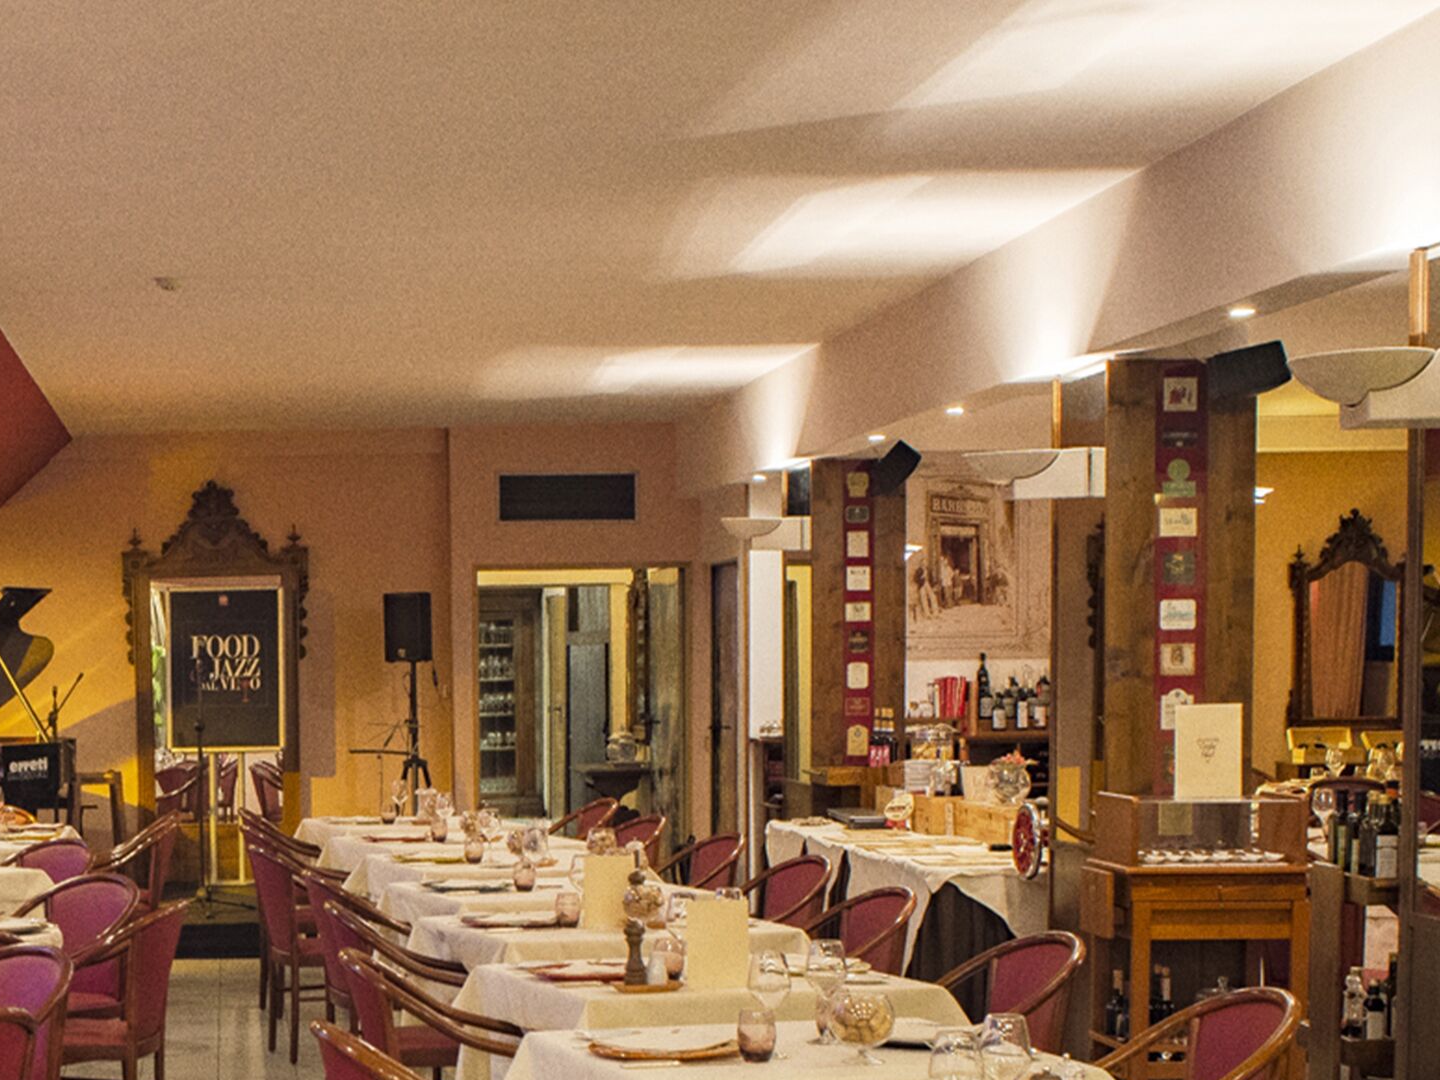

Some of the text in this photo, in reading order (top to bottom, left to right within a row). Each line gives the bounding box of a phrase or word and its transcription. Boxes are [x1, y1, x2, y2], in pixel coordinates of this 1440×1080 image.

[190, 635, 260, 659] FOOD
[209, 658, 261, 681] JAZZ
[220, 677, 261, 691] VIO
